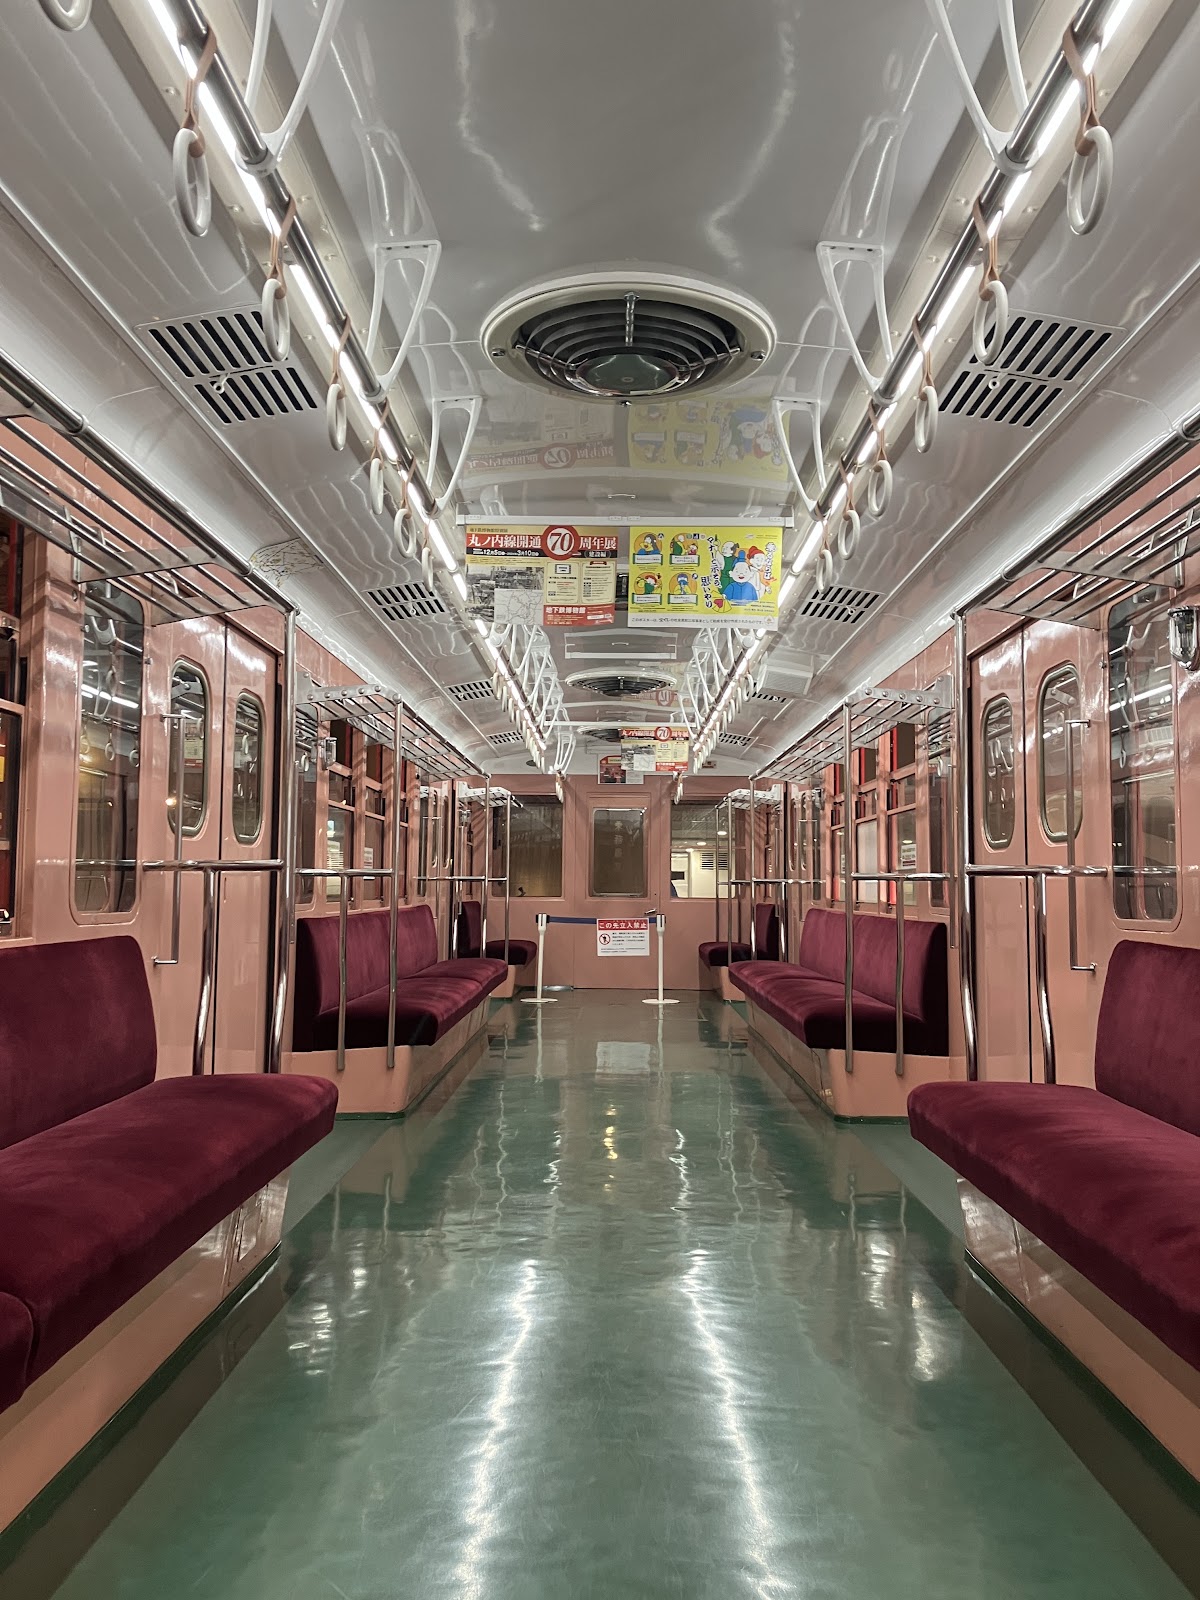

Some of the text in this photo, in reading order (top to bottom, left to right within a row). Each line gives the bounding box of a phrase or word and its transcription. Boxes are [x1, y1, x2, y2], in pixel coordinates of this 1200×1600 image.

[468, 532, 617, 552] 丸ノ内線開通 70 周年展
